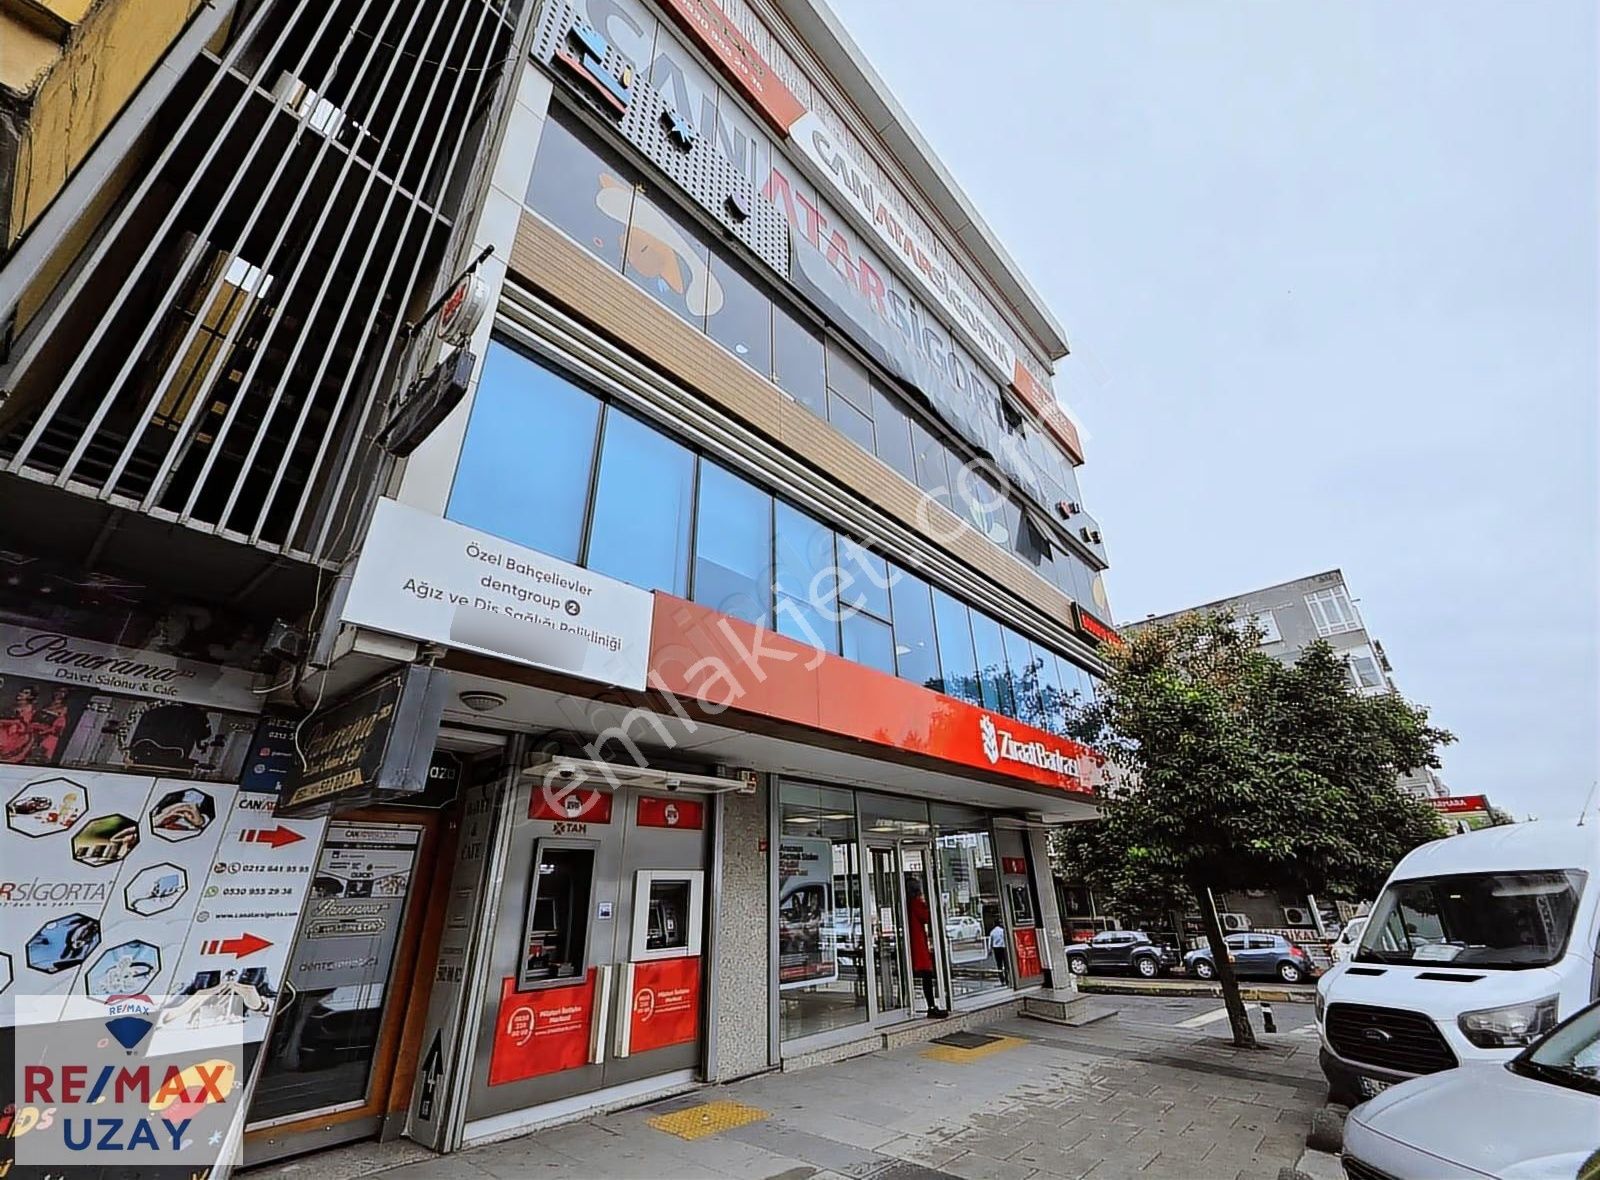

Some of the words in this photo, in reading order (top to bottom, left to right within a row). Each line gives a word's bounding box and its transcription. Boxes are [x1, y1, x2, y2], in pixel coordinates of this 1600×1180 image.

[465, 541, 502, 567] Özel
[506, 553, 593, 596] Bahçelievler
[402, 577, 444, 600] Ağız
[449, 592, 469, 606] ve
[480, 574, 561, 610] dentgroup
[7, 634, 178, 682] Panorama
[55, 668, 92, 683] Davet
[95, 676, 135, 690] Salonu
